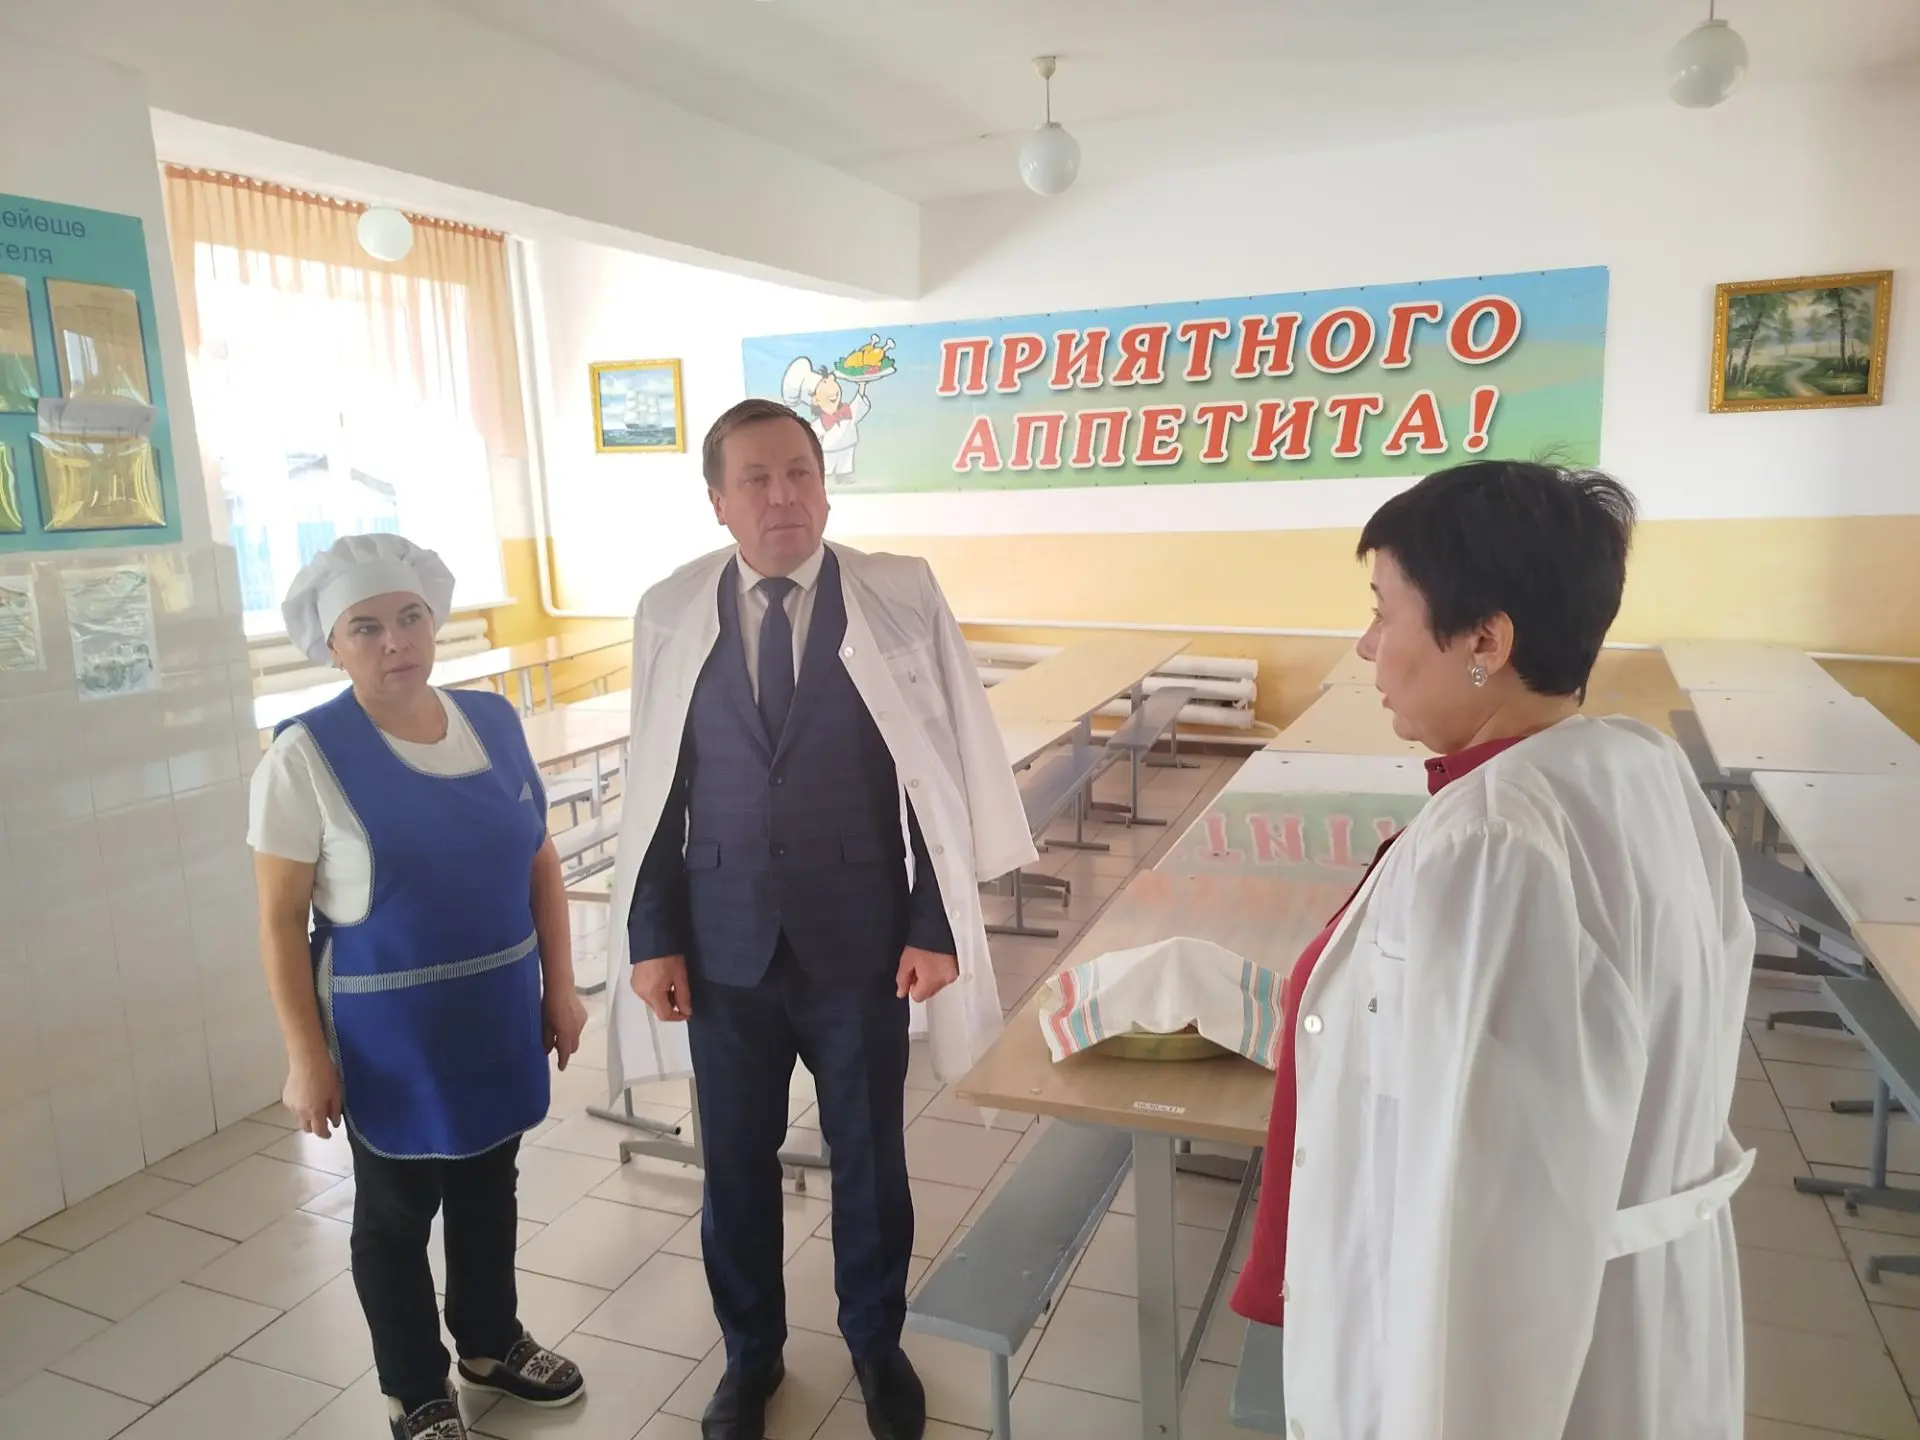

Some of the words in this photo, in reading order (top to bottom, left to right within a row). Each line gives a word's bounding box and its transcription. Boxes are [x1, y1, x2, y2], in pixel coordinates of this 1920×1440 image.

[0, 206, 86, 238] өйөшө
[937, 296, 1520, 394] ПРИЯТНОГО
[953, 386, 1498, 470] АППЕТИТА!
